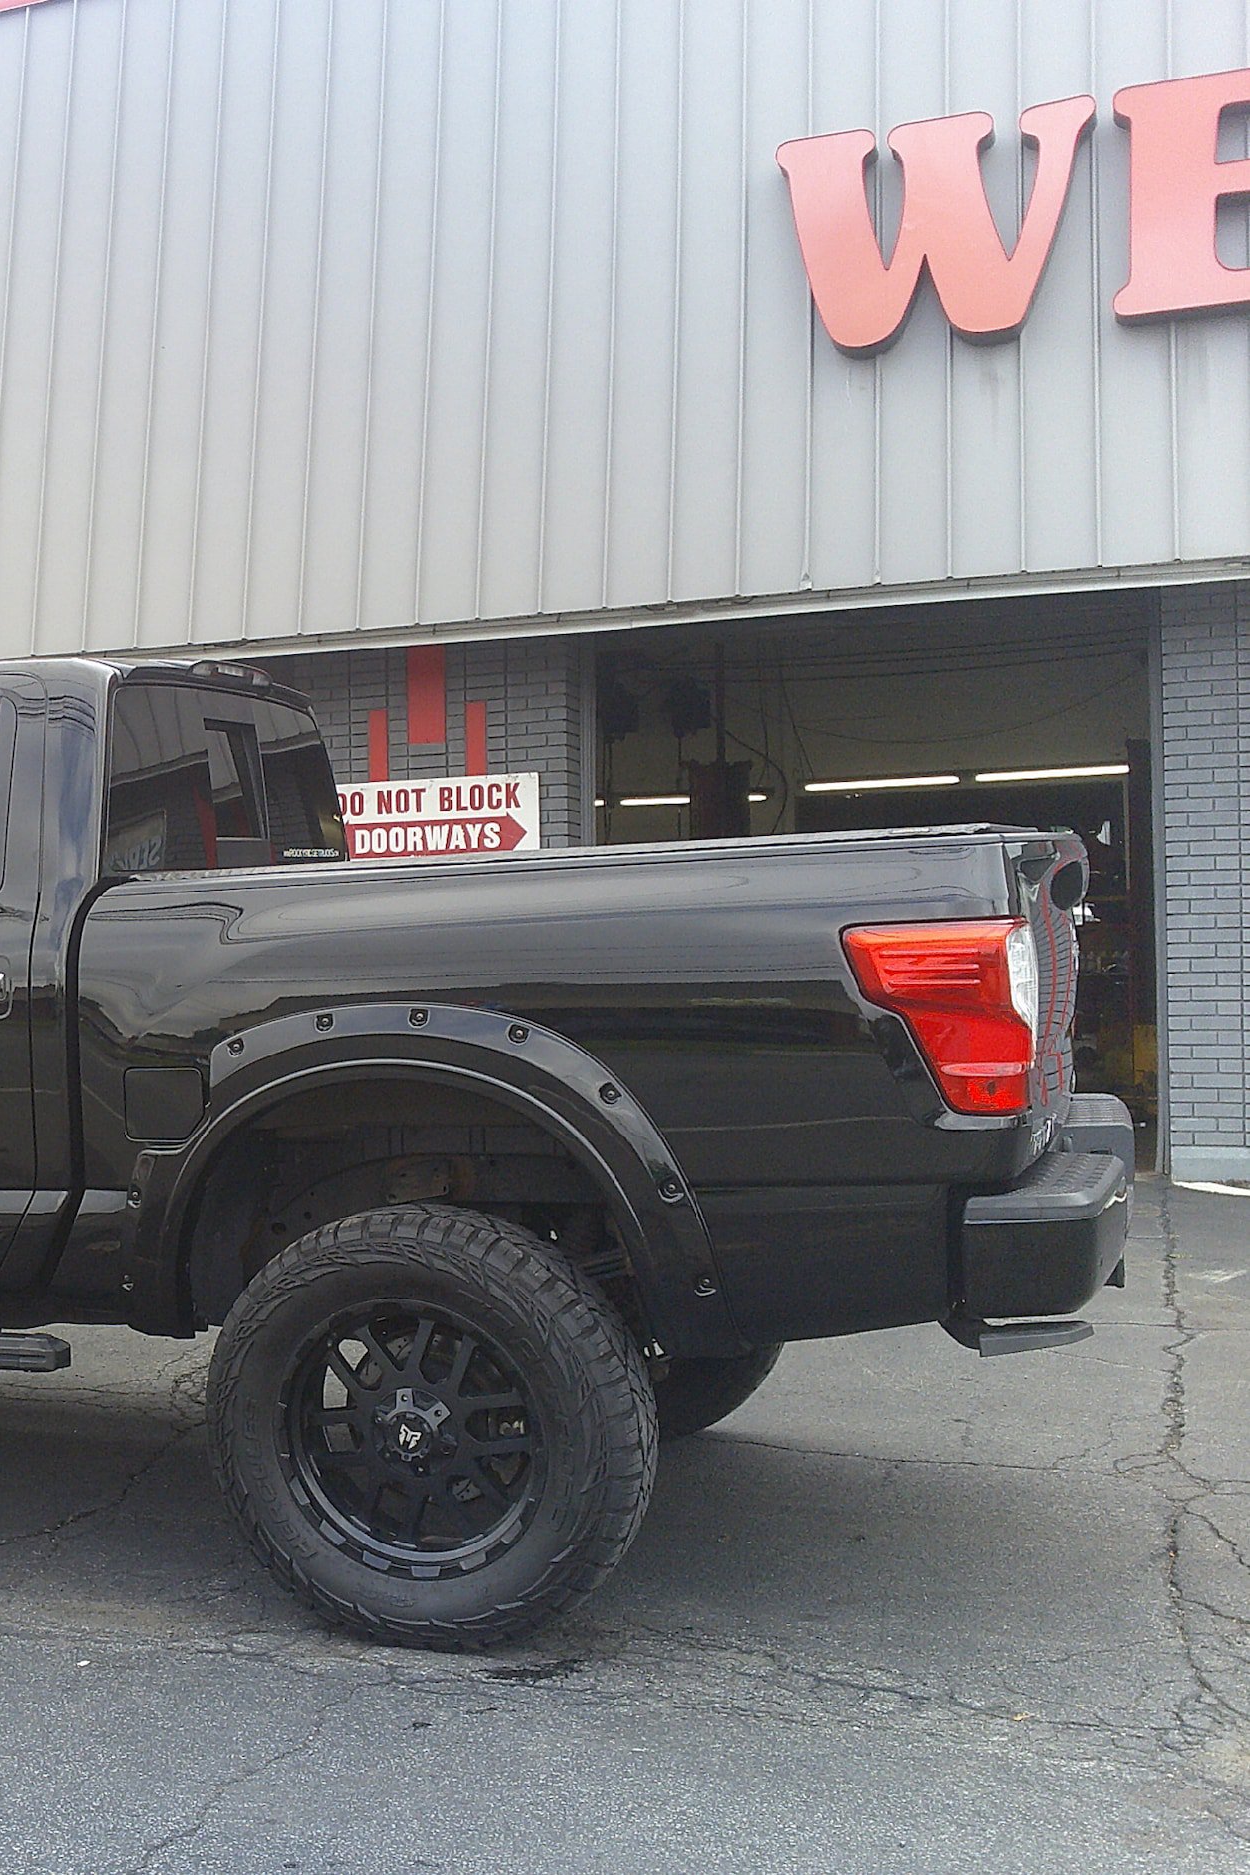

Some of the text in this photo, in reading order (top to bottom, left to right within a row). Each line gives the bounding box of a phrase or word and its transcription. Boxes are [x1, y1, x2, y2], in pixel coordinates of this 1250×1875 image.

[377, 788, 427, 814] NOT
[439, 782, 521, 812] BLOCK
[355, 821, 501, 855] DOORWAYS
